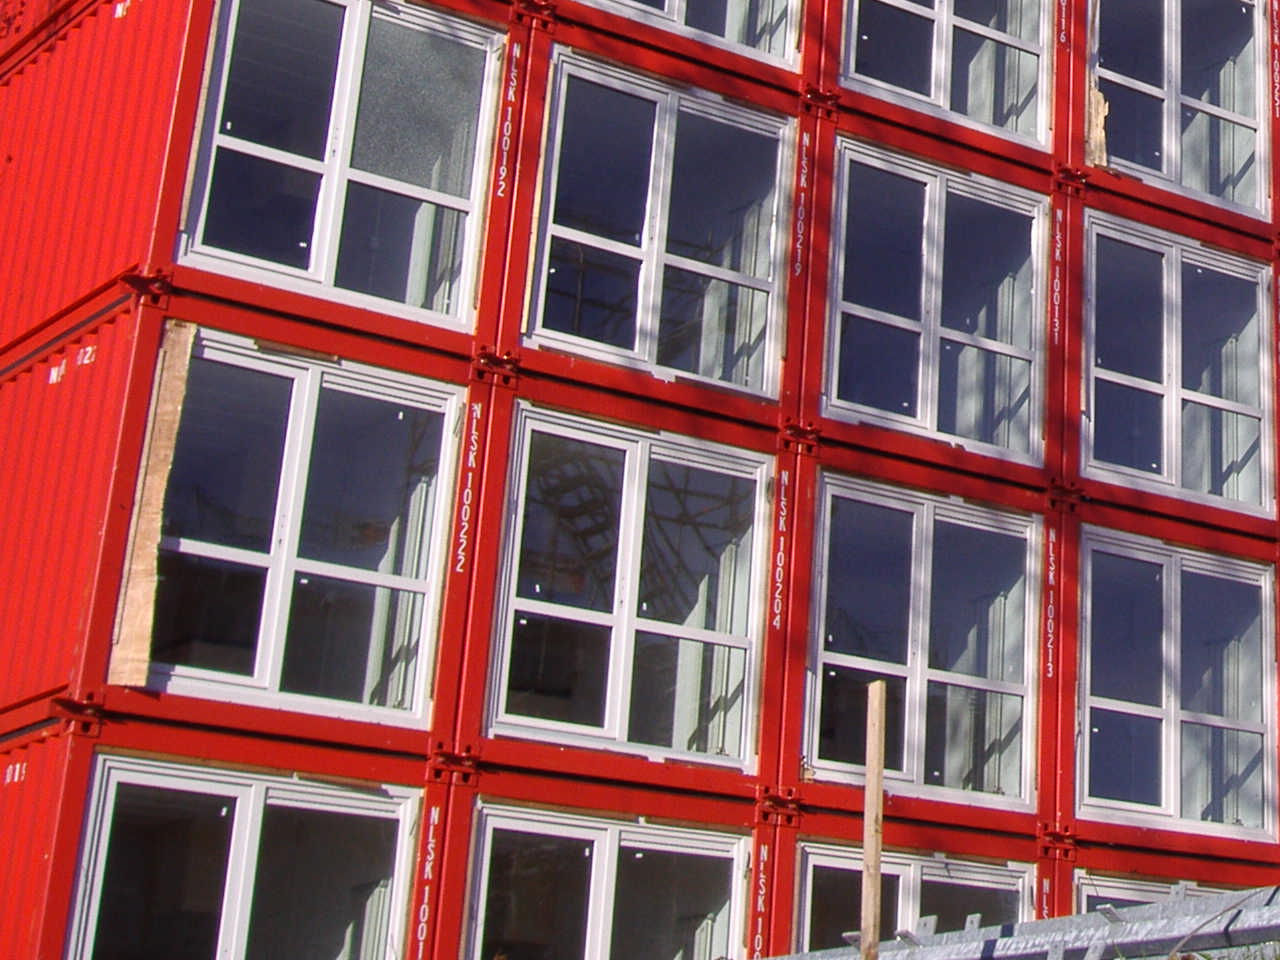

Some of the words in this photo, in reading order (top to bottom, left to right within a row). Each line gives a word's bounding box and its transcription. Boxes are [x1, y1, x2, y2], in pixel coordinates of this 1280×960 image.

[508, 42, 521, 102] NLSK
[497, 106, 512, 197] 100192
[800, 132, 810, 188] NLSK
[1055, 208, 1063, 262] NLSK
[468, 402, 482, 468] NLSK
[456, 471, 473, 572] 100222
[779, 469, 789, 532] NLSK
[773, 535, 785, 630] 100204
[1048, 527, 1056, 585] NLSK
[1046, 589, 1055, 678] 100213
[424, 806, 440, 880] NLSK
[757, 844, 768, 913] NLSK
